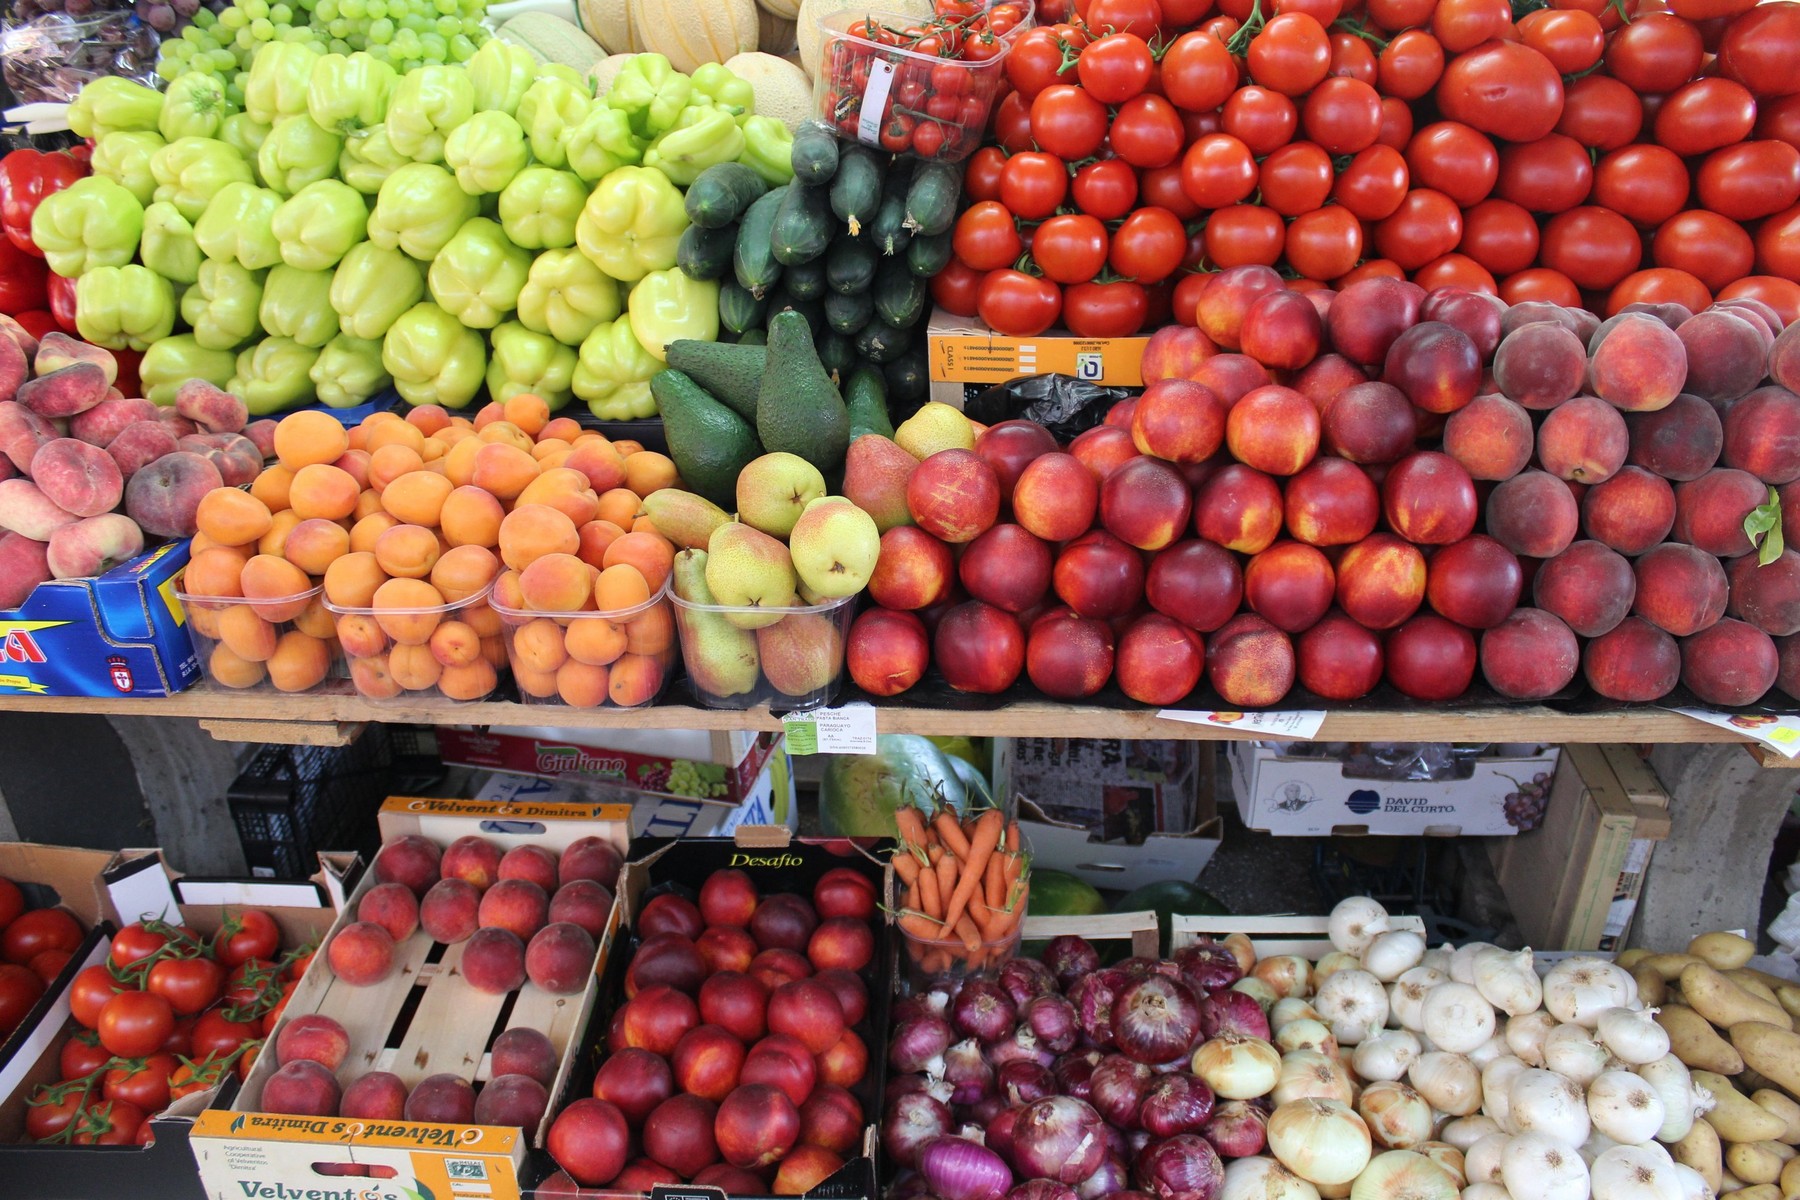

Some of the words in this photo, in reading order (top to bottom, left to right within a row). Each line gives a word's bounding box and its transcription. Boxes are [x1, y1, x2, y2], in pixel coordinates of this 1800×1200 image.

[536, 752, 627, 773] Giuliano
[1385, 797, 1428, 806] DAVID
[526, 806, 587, 818] Dimitra
[1384, 805, 1409, 813] DEL
[1410, 805, 1454, 813] CURTO
[730, 853, 803, 869] Desafio
[250, 1116, 330, 1134] Dimitra
